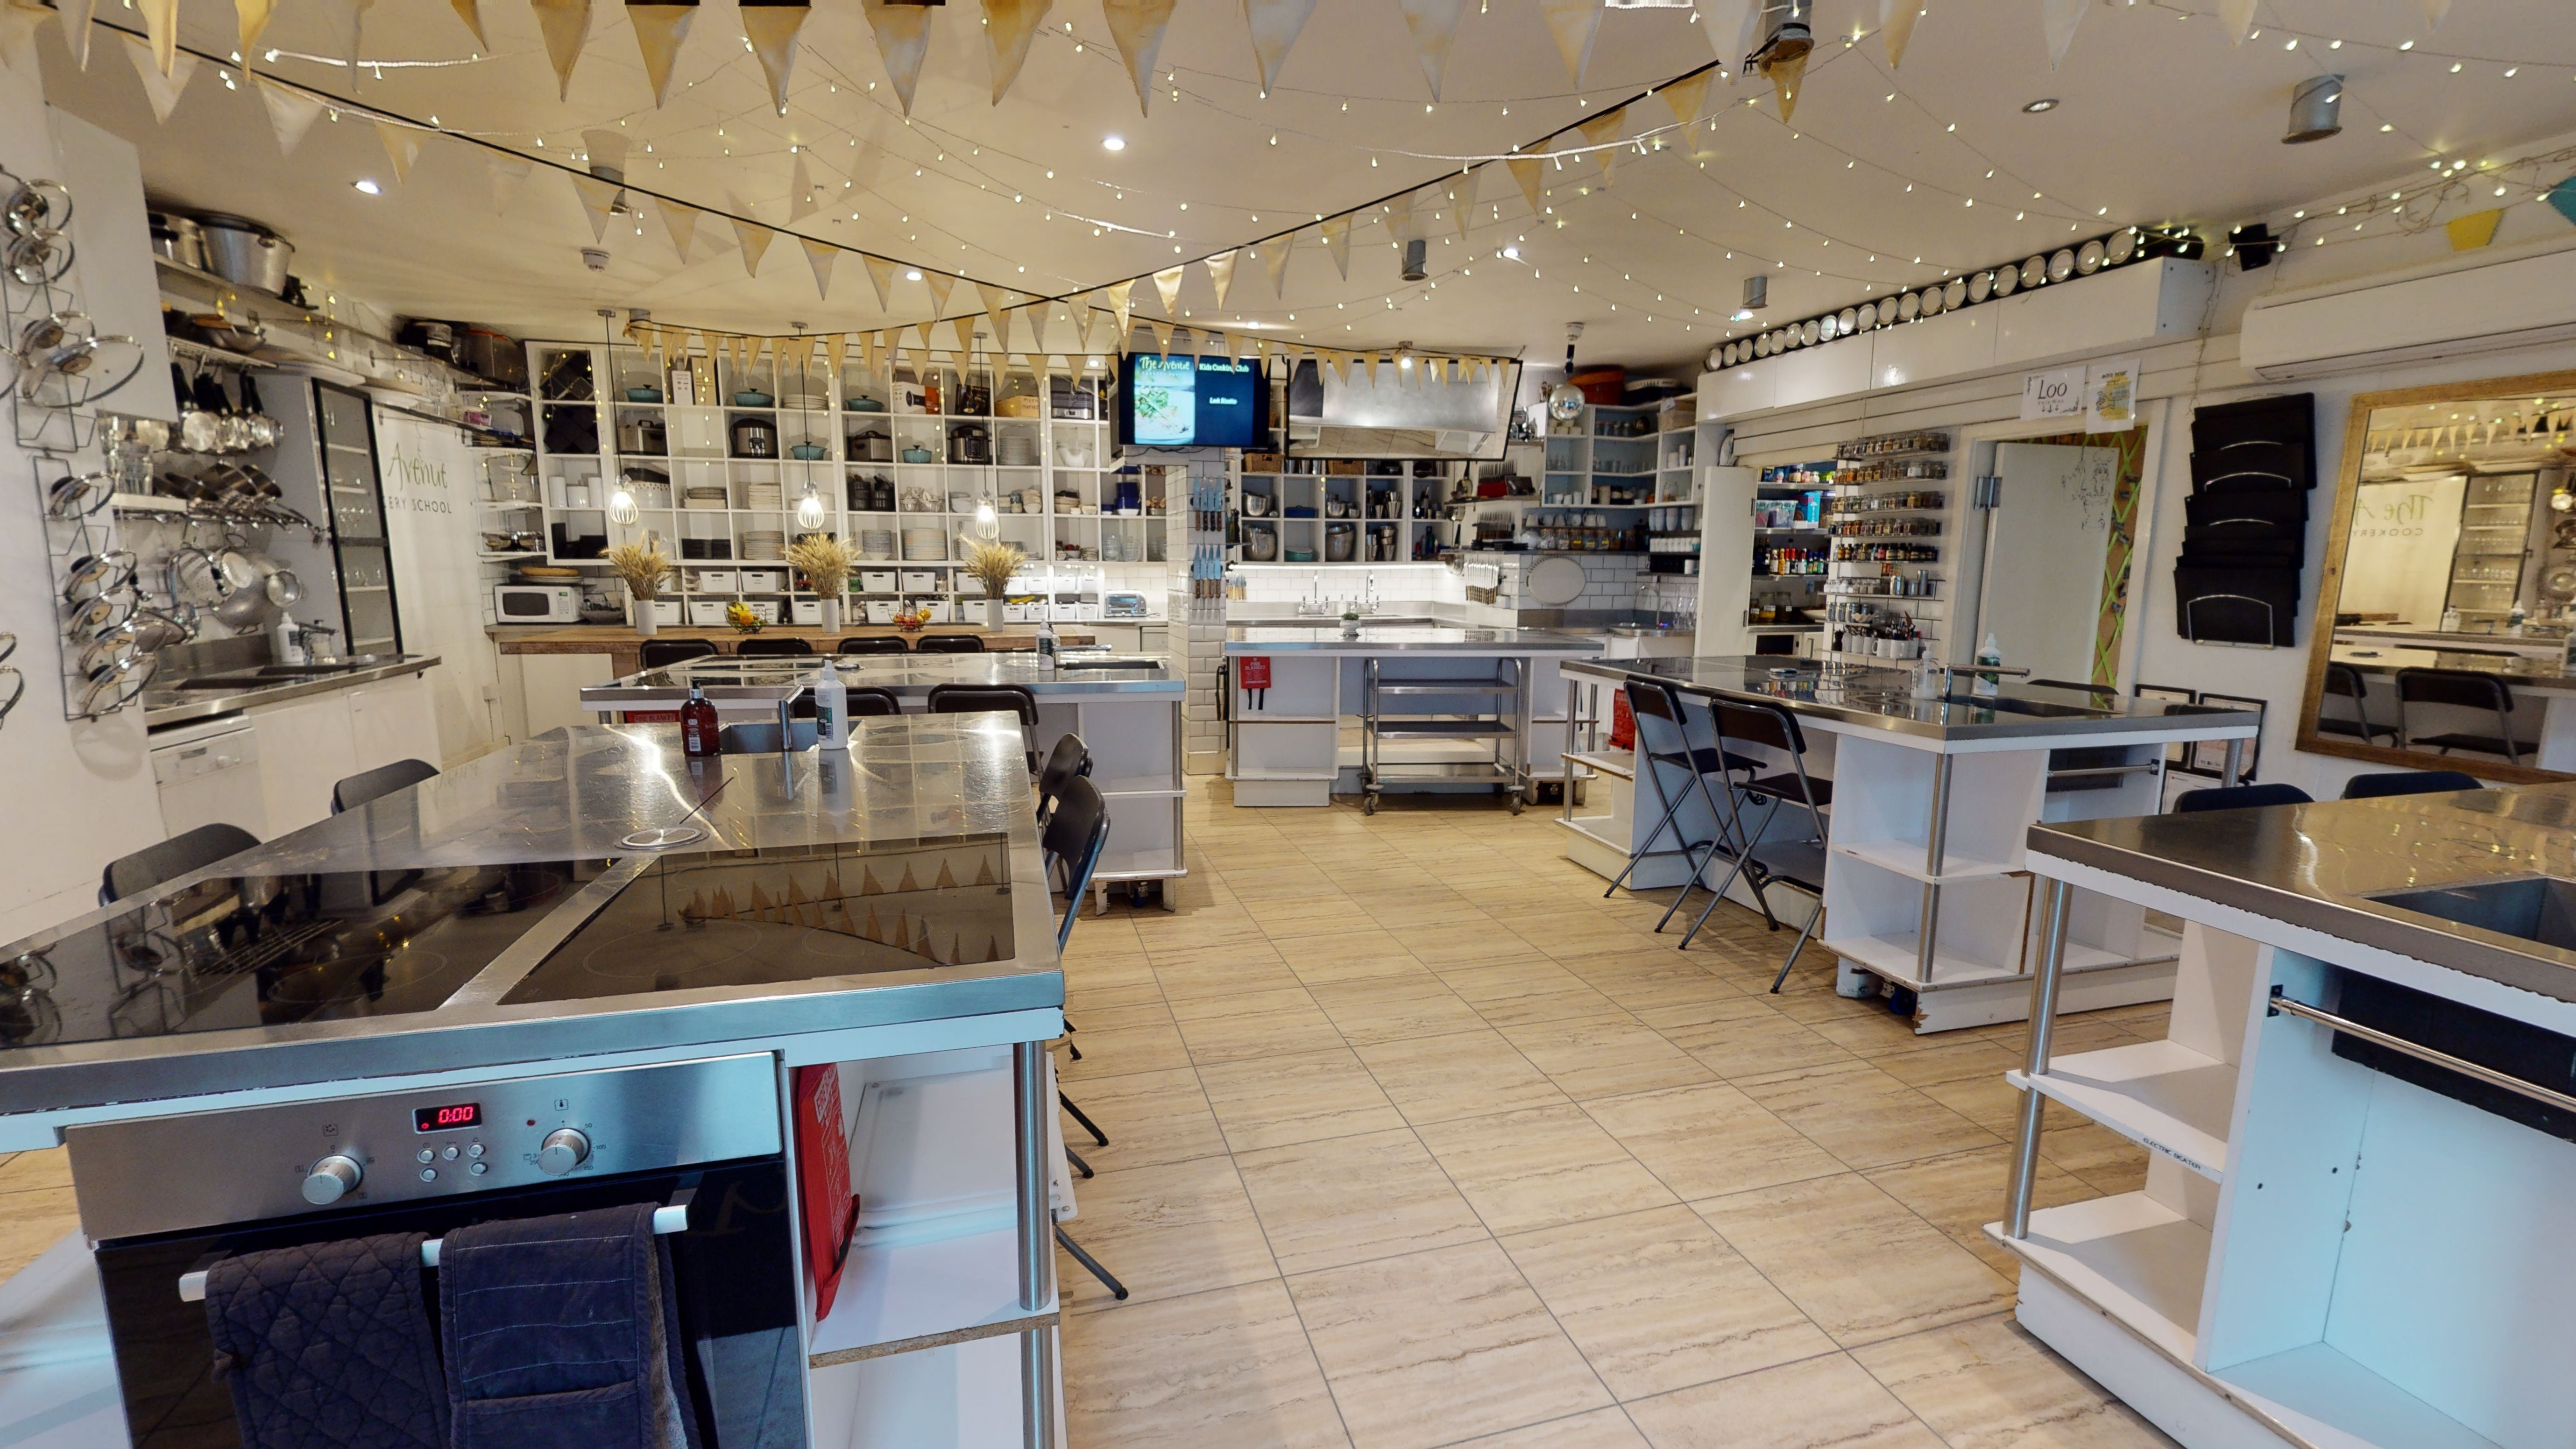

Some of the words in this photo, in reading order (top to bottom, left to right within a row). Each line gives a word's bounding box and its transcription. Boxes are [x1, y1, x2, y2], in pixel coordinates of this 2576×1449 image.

[1139, 356, 1157, 371] The
[388, 442, 448, 491] Avenue
[389, 496, 407, 509] ERY
[412, 499, 452, 514] SCHOOL
[438, 1106, 474, 1123] 0:00
[2143, 1138, 2172, 1156] ELECTRIC
[2174, 1153, 2201, 1170] BEATER
